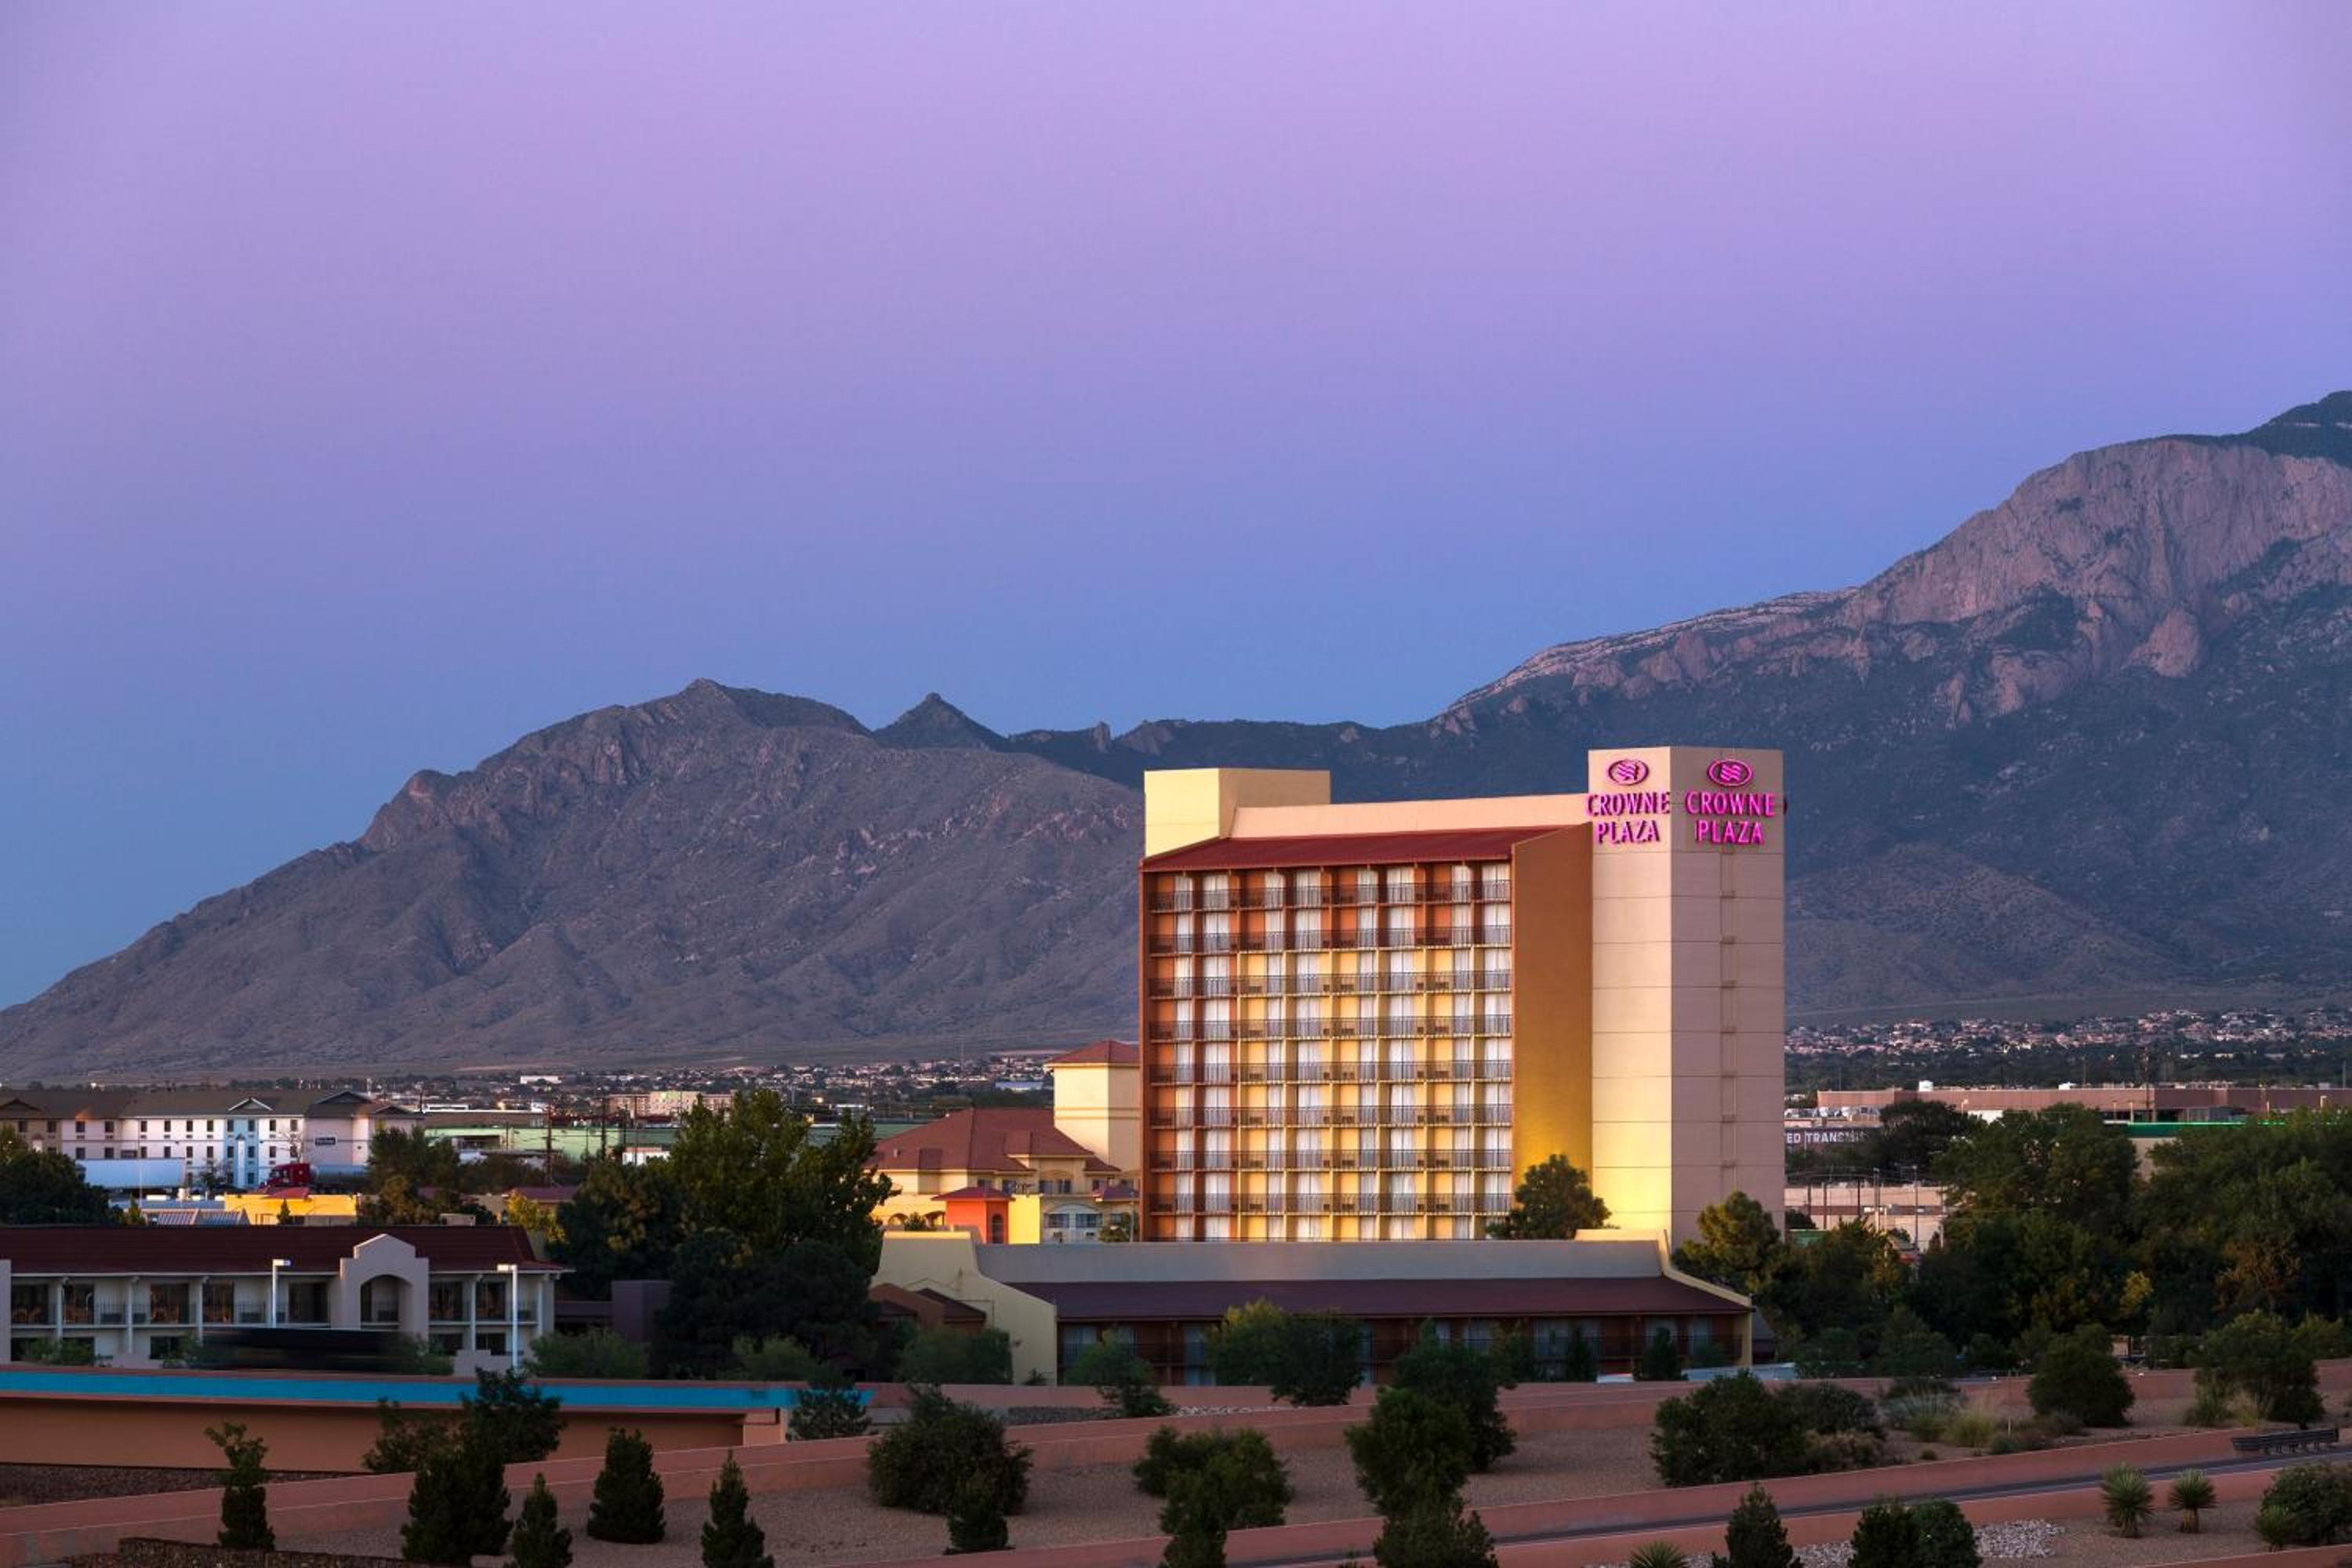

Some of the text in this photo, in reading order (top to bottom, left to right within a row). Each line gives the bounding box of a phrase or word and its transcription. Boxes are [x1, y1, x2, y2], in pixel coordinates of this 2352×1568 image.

[1587, 792, 1670, 816] CROWNE
[1686, 792, 1775, 817] CROWNE
[1597, 820, 1661, 844] PLAZA
[1696, 820, 1763, 844] PLAZA
[1784, 1133, 1801, 1144] ED
